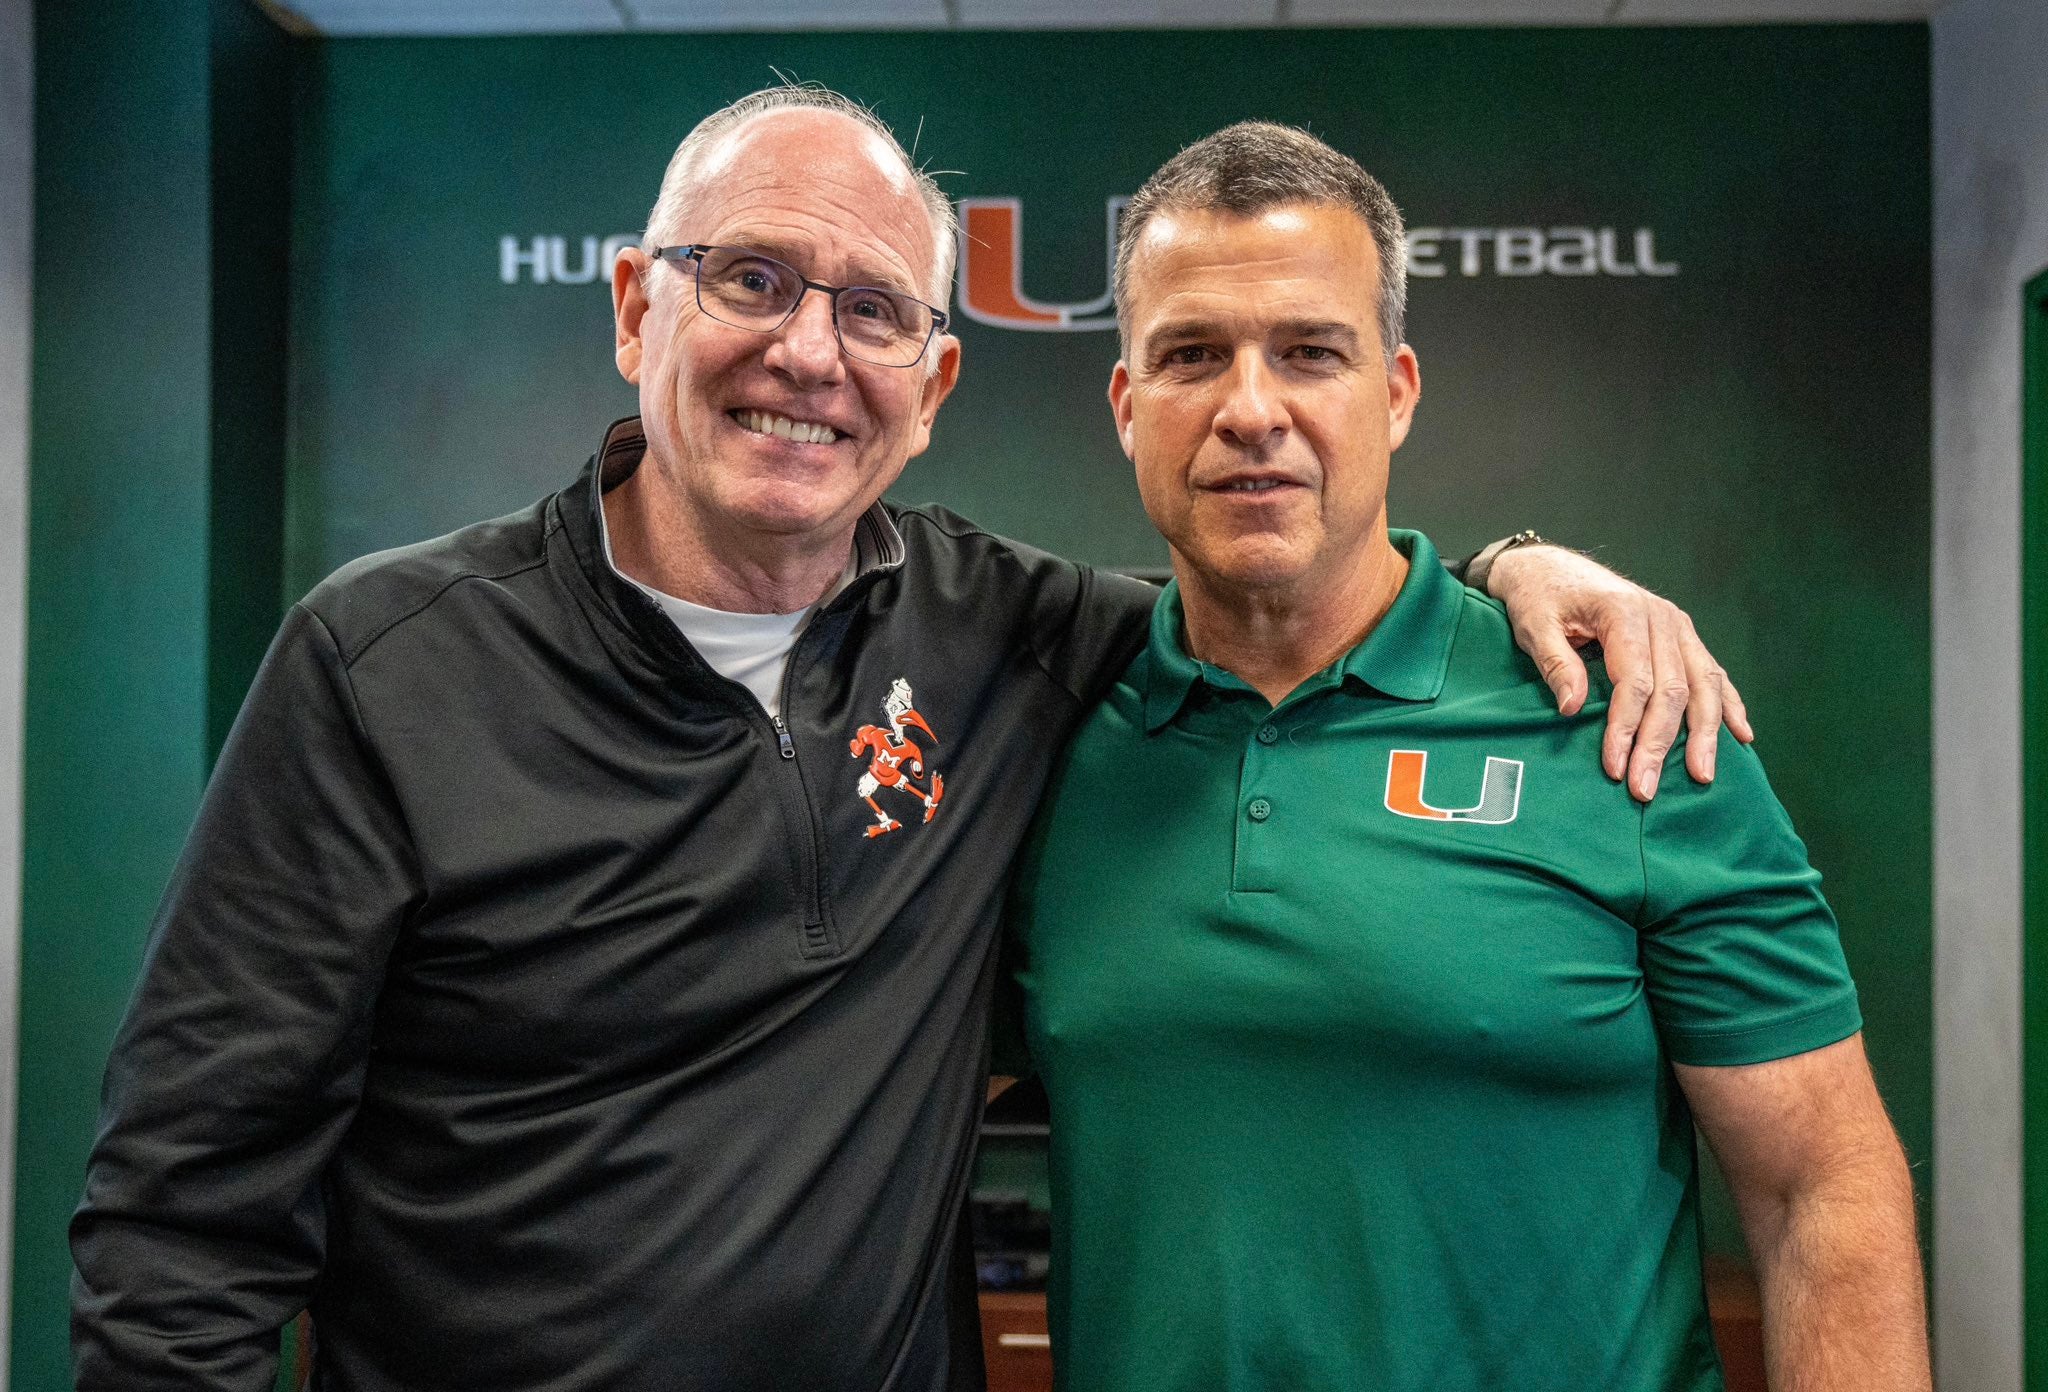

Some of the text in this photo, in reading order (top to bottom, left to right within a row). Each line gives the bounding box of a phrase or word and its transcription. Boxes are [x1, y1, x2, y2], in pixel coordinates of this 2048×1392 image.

[957, 195, 1135, 332] U
[877, 749, 901, 768] M
[1384, 749, 1524, 825] U
